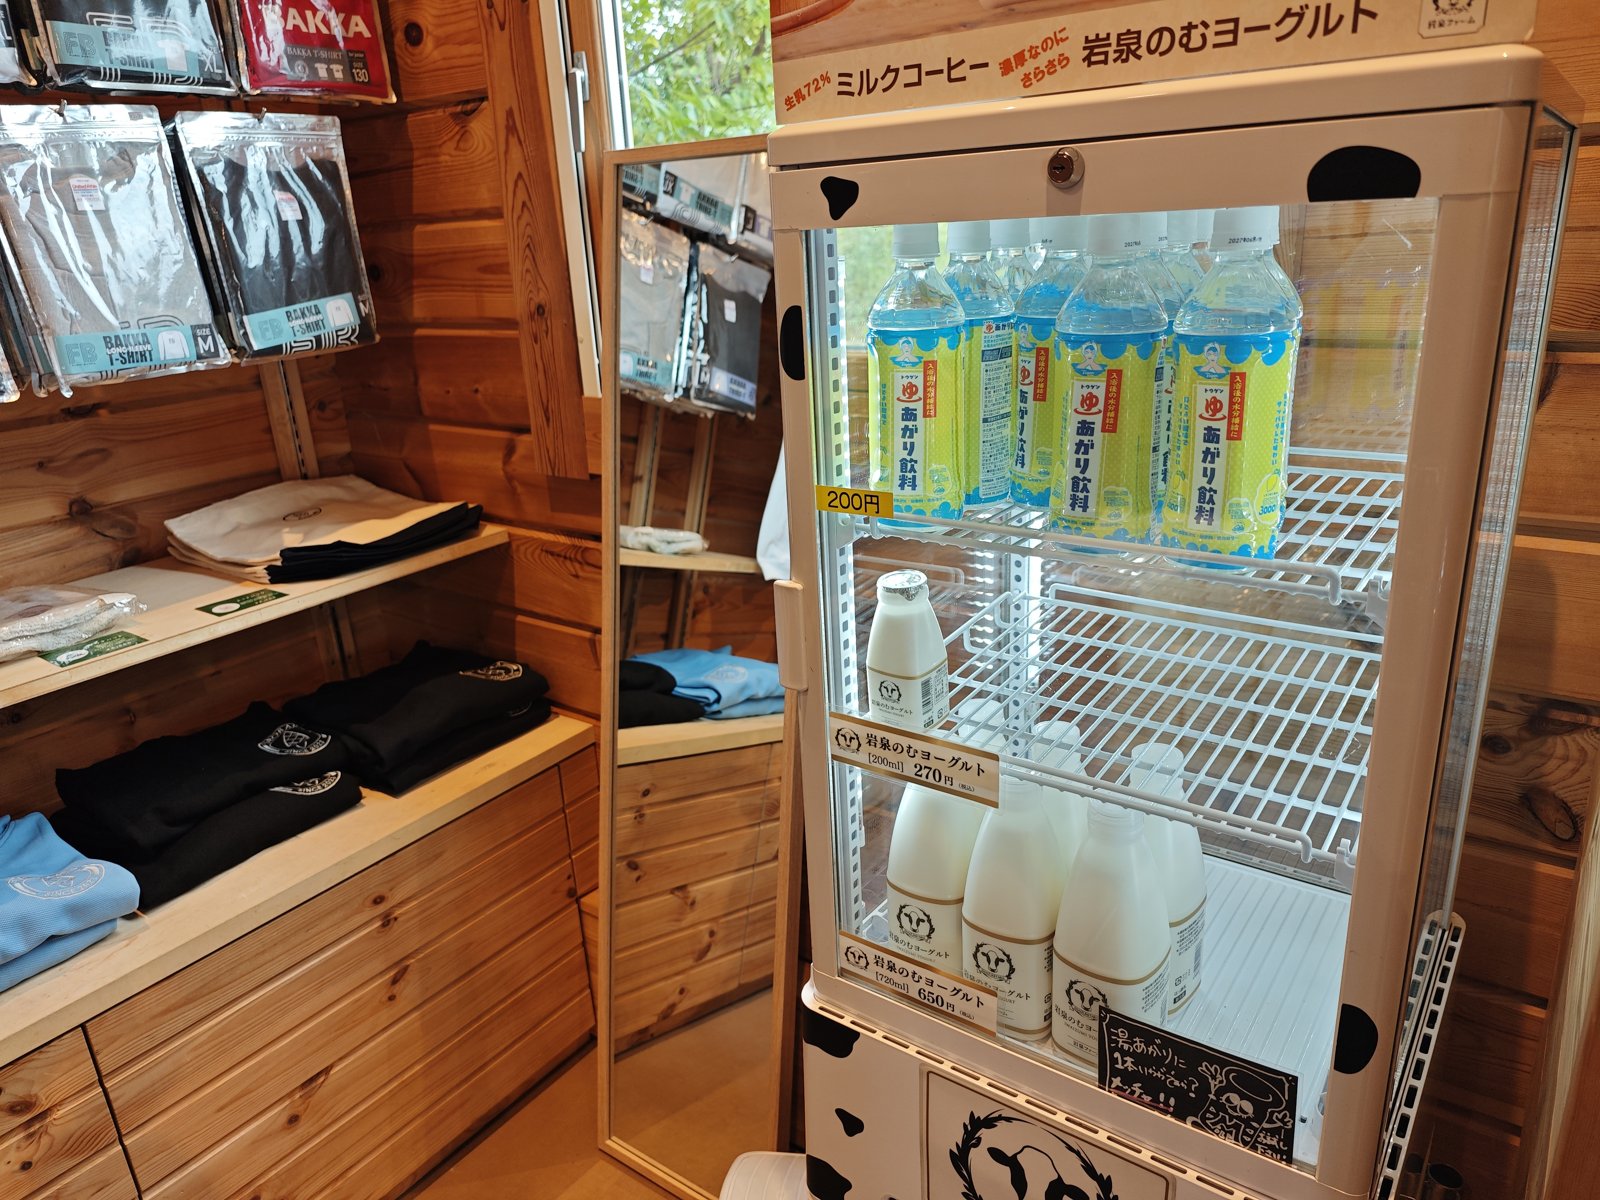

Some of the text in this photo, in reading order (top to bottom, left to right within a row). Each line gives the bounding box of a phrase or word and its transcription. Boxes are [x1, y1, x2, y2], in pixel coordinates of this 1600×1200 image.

[276, 4, 373, 38] AKKA
[1081, 0, 1378, 68] 岩泉のむヨーグルト
[203, 54, 223, 74] XL
[998, 27, 1070, 78] 濃厚なのに
[352, 68, 369, 82] 130
[836, 56, 990, 98] ミルクコーヒー
[1020, 52, 1071, 90] さらさら
[784, 70, 832, 112] 生乳72%
[284, 304, 322, 323] BAKKA
[289, 320, 327, 338] T-SHIRT
[103, 332, 151, 350] BAKKA
[196, 328, 211, 336] SIZE
[197, 335, 215, 354] M
[106, 349, 155, 367] T-SHIRT
[898, 406, 919, 491] あがり飲料
[1069, 419, 1096, 513] あがり飲料
[1193, 425, 1221, 527] あがり飲料
[827, 490, 880, 514] 200円
[865, 732, 986, 777] 岩泉のむヨーグルト
[868, 752, 904, 773] [200ml]
[914, 762, 954, 787] 270円
[889, 931, 951, 959] 岩泉のむヨーグルト
[872, 954, 985, 1008] 岩泉のむヨーグルト
[875, 970, 910, 994] [720ml]
[917, 987, 956, 1013] 650円
[1054, 1003, 1098, 1033] 岩泉のむヨー
[1073, 1041, 1097, 1055] 岩泉ファー
[1110, 1027, 1187, 1069] 湯あがりに
